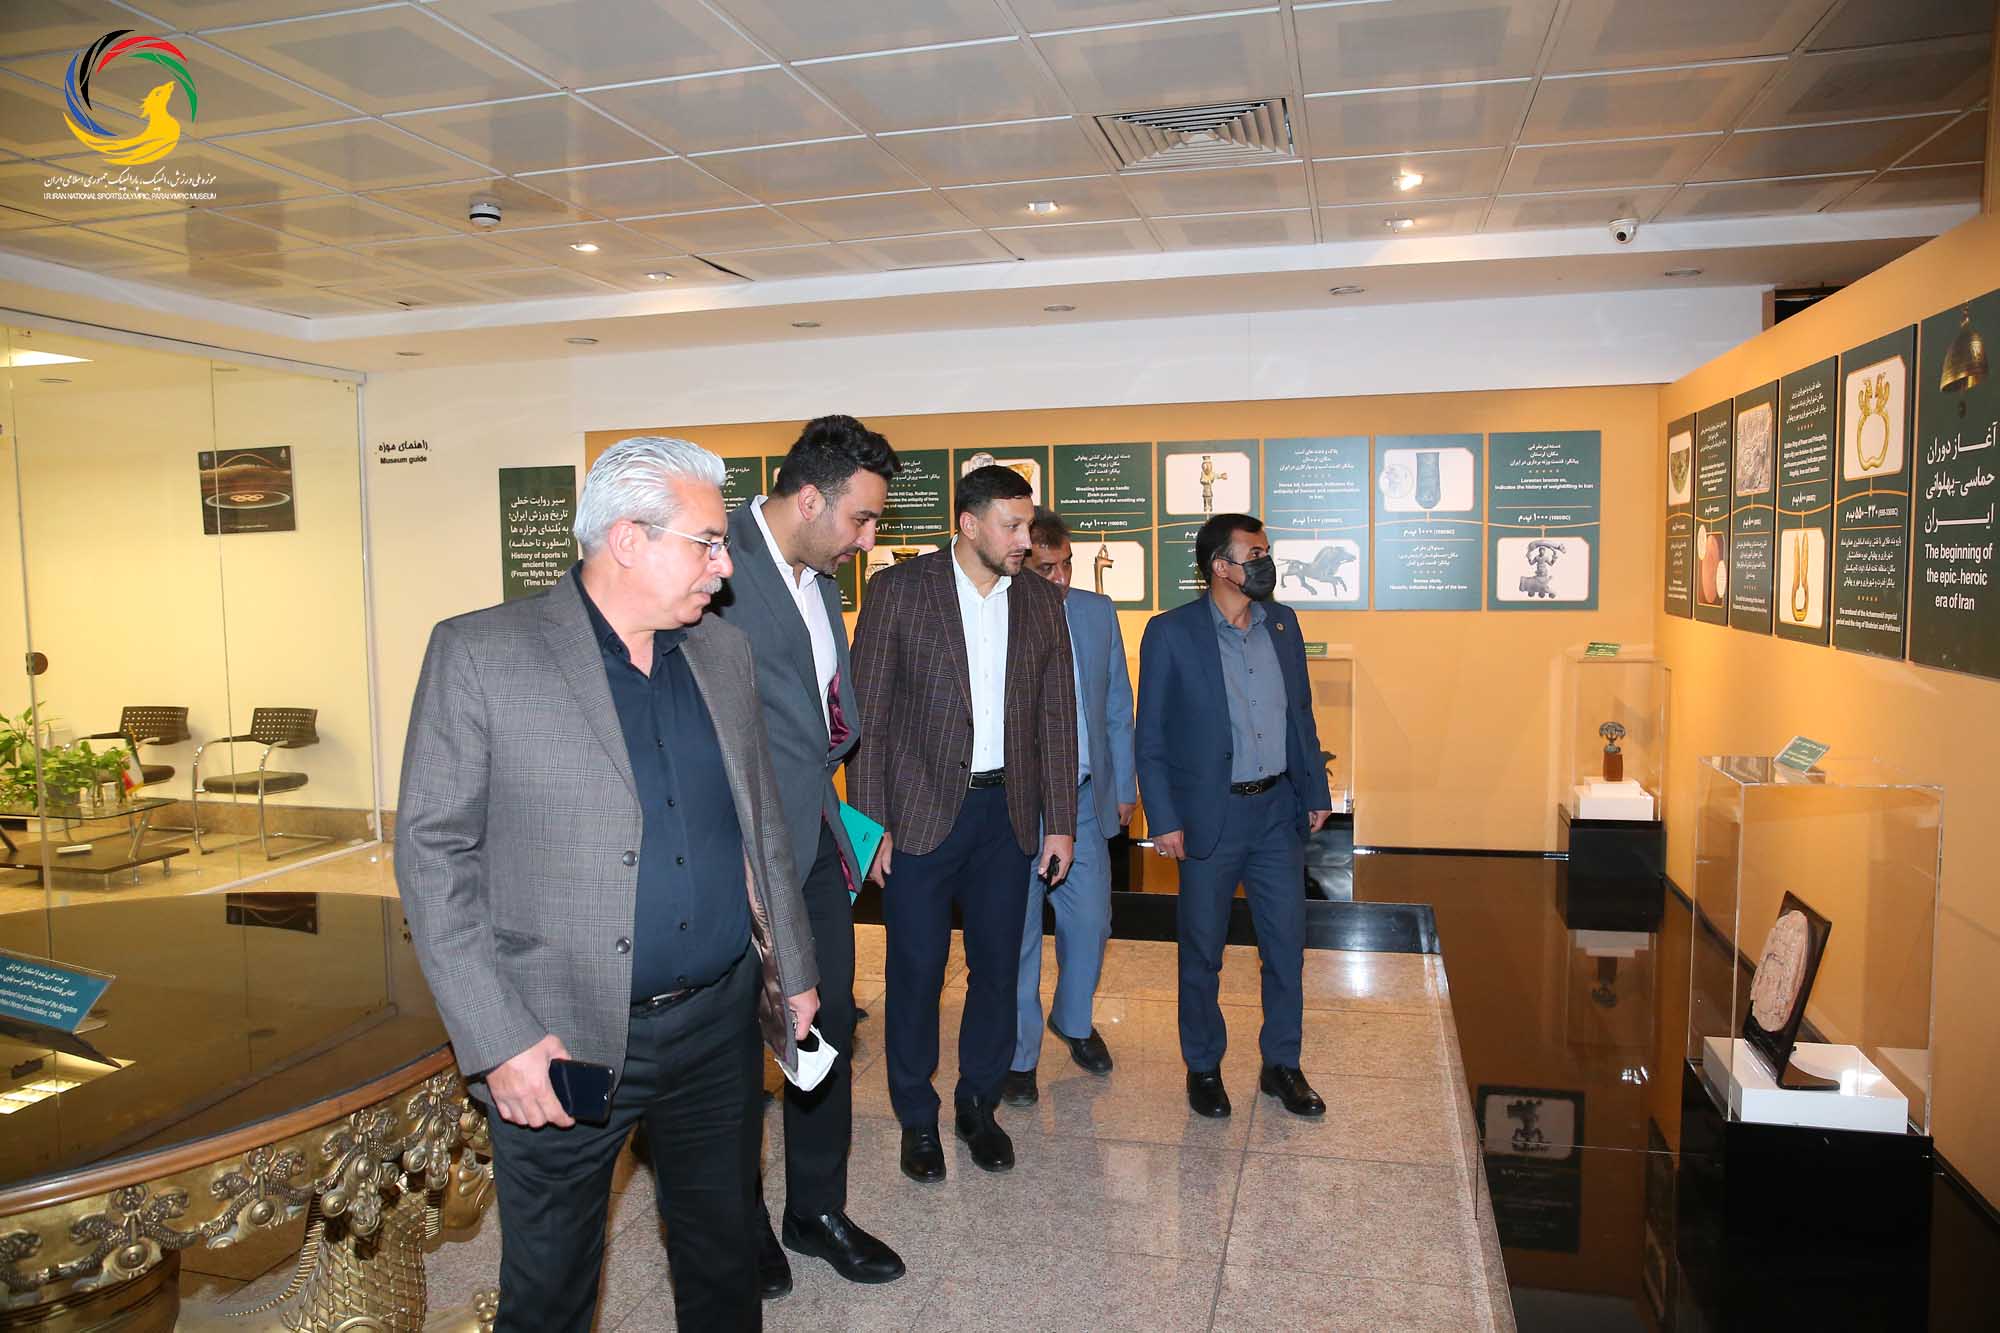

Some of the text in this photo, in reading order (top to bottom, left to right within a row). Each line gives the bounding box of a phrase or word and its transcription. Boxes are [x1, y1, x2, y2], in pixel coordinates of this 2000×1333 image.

[398, 440, 428, 451] راهنمای
[1927, 421, 1999, 465] آغاز دوران
[511, 496, 566, 508] سیر روایت خطی
[529, 510, 549, 521] ورزش
[550, 509, 569, 521] تاریخ
[1925, 502, 1994, 533] ایران
[511, 525, 518, 533] ها
[519, 524, 537, 536] هزاره
[562, 526, 569, 535] به
[509, 538, 535, 548] حماسه)
[542, 537, 571, 550] (اسطوره
[511, 552, 533, 560] History
[541, 552, 560, 560] sports
[1925, 542, 1993, 564] The beginning of
[511, 570, 529, 578] (From
[530, 570, 545, 578] Myth
[1926, 567, 1939, 583] the
[524, 579, 540, 588] (Time
[1935, 593, 1975, 611] era of Iran
